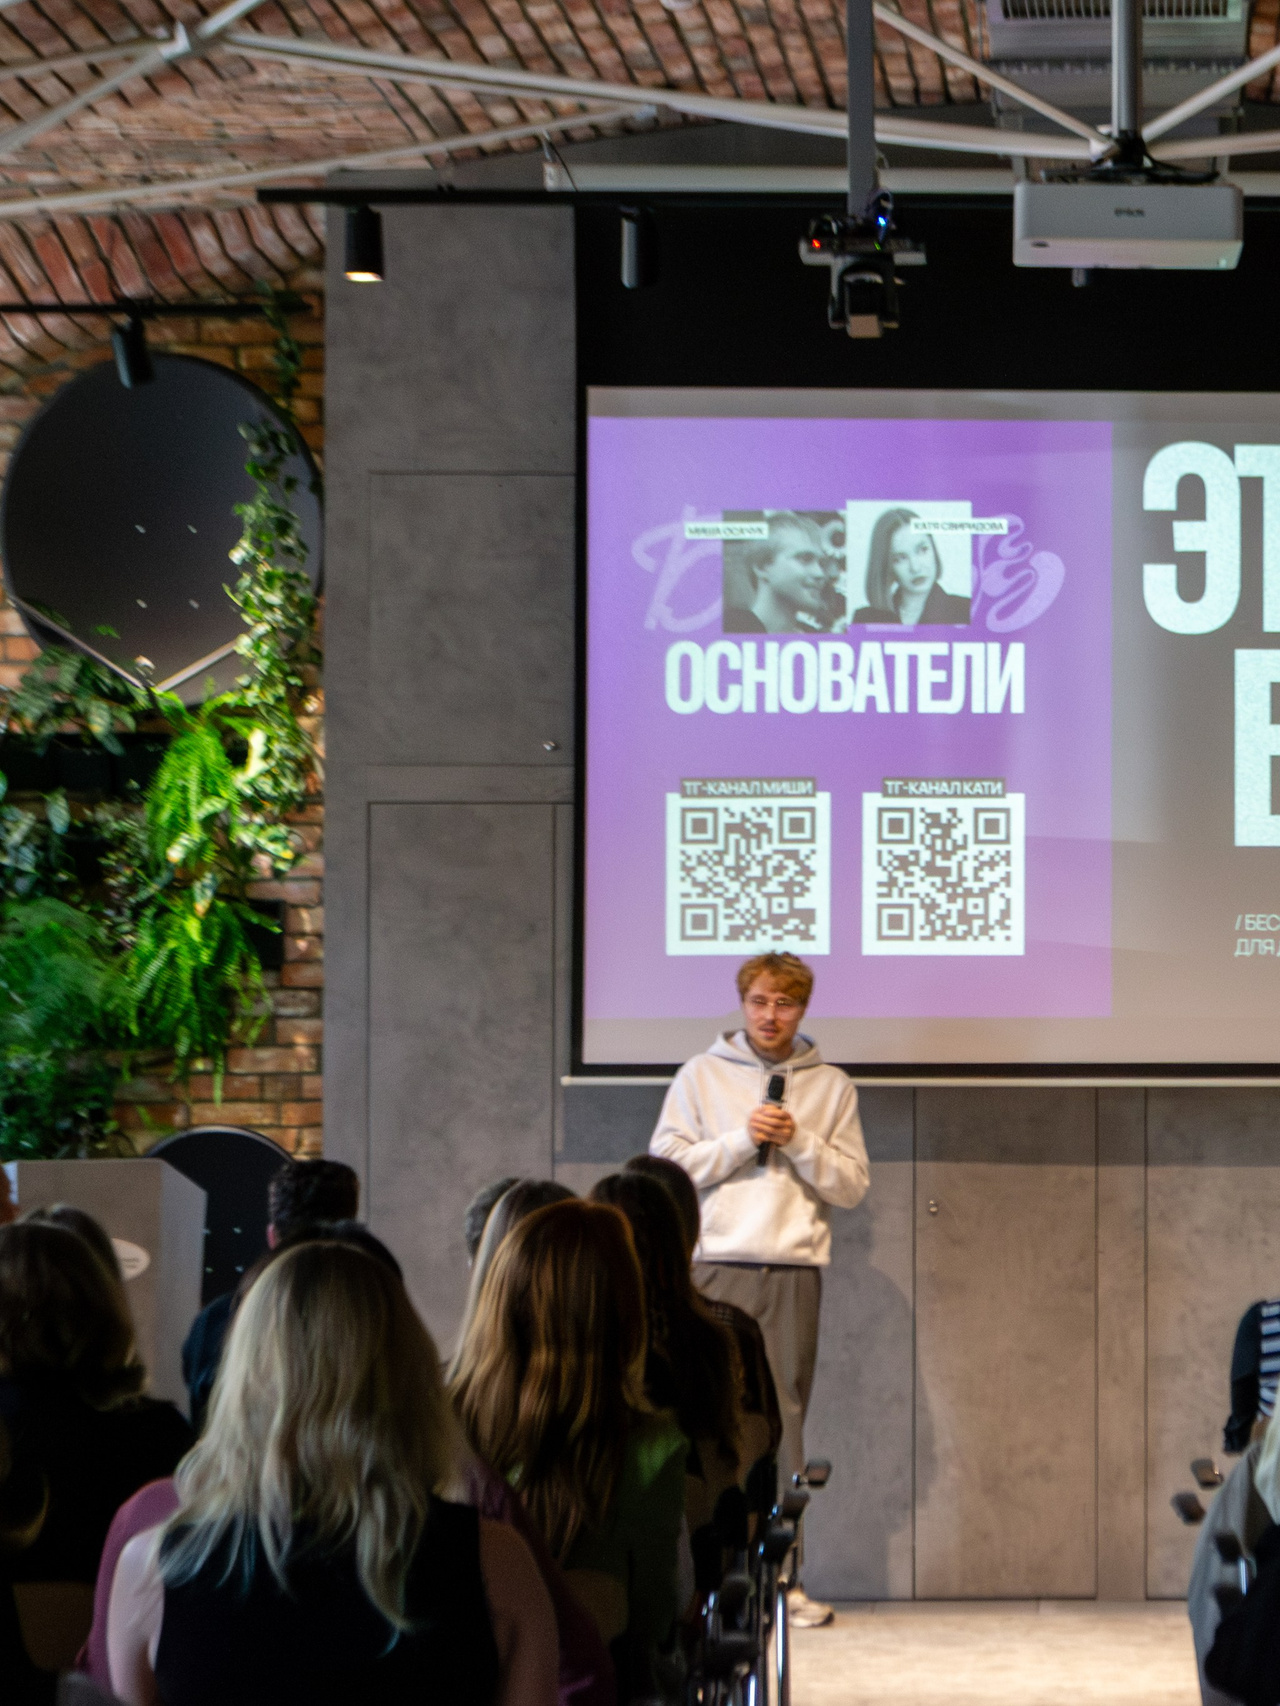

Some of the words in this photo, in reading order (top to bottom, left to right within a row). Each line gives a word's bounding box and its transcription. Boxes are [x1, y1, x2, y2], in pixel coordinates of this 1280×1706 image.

[665, 640, 1025, 715] ОСНОВАТЕЛИ
[684, 781, 760, 796] ТГ-КАНАЛ
[762, 781, 814, 796] МИШИ
[884, 780, 961, 795] ТГ-КАНАЛ
[963, 780, 1003, 795] КАТИ
[1234, 938, 1275, 957] ДЛЯ
